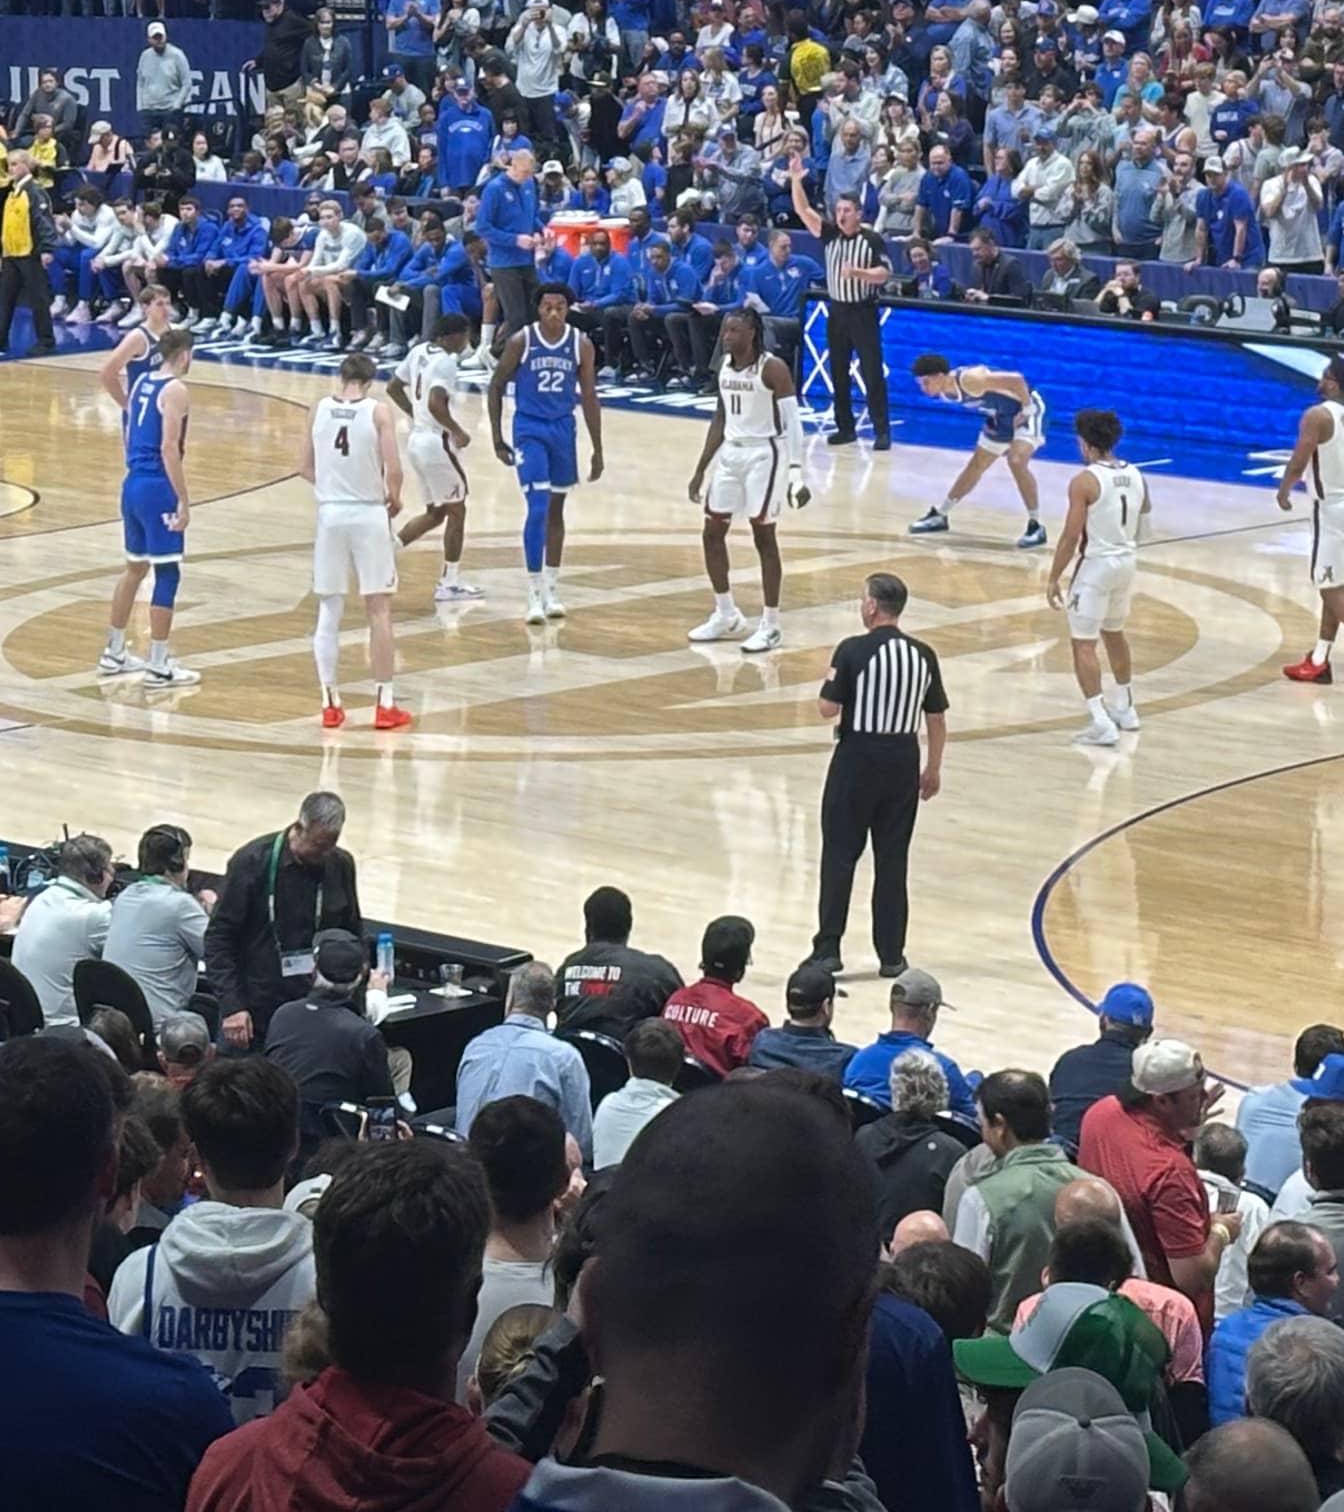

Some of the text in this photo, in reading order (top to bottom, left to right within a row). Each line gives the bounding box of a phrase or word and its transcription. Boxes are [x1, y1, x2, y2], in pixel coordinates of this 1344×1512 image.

[529, 356, 573, 371] KENTUCKY
[537, 370, 565, 392] 22
[137, 396, 149, 427] 7
[730, 393, 742, 415] 11
[334, 425, 348, 457] 4
[1119, 493, 1128, 526] 1
[664, 1003, 720, 1029] CULTURE
